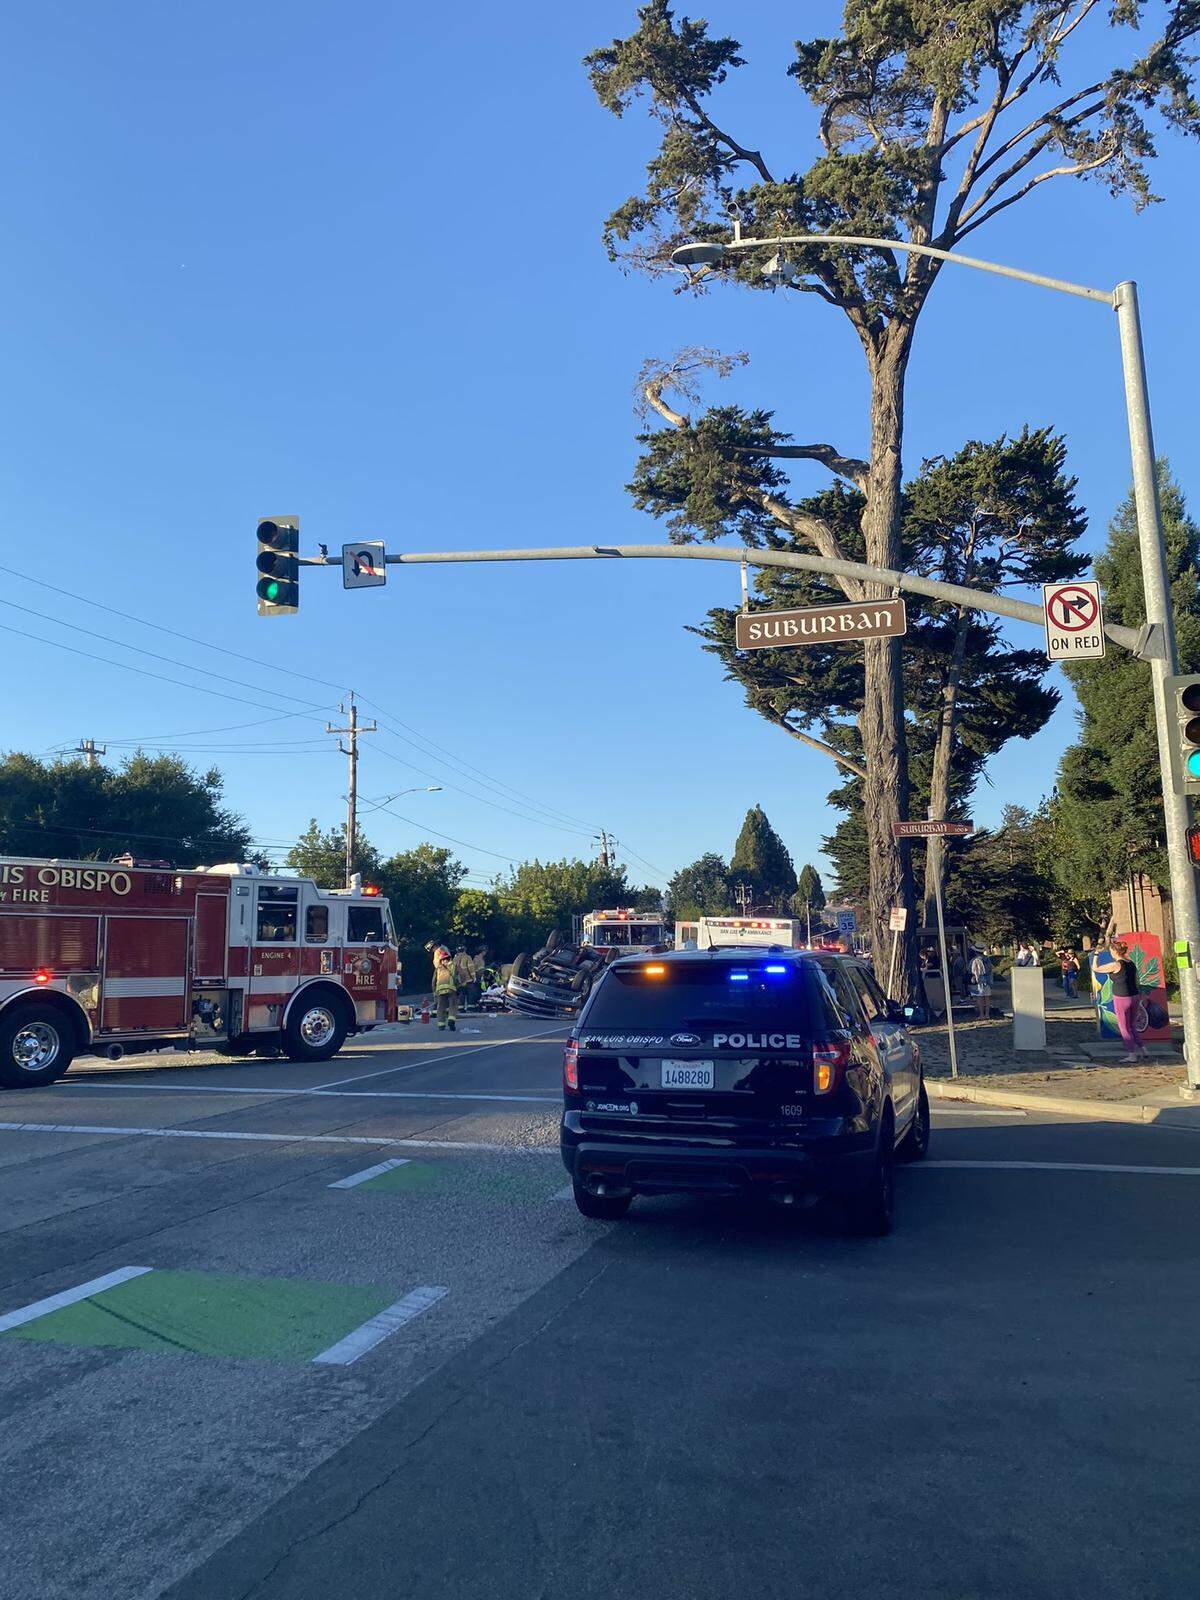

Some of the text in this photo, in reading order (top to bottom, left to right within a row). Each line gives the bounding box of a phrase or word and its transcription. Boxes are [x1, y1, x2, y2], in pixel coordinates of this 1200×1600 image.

[749, 610, 893, 641] SUBURBAN
[1051, 636, 1100, 651] ON RED
[900, 824, 948, 834] SUBURBAN
[38, 868, 131, 896] OBISPO
[12, 889, 50, 903] FIRE
[841, 921, 855, 931] 35
[261, 952, 292, 960] ENGINE 4
[355, 974, 375, 985] FIRE
[584, 1035, 664, 1045] SAN LUIS OBISPO
[713, 1033, 801, 1049] POLICE
[665, 1070, 710, 1085] 1488280
[780, 1105, 802, 1117] 1609
